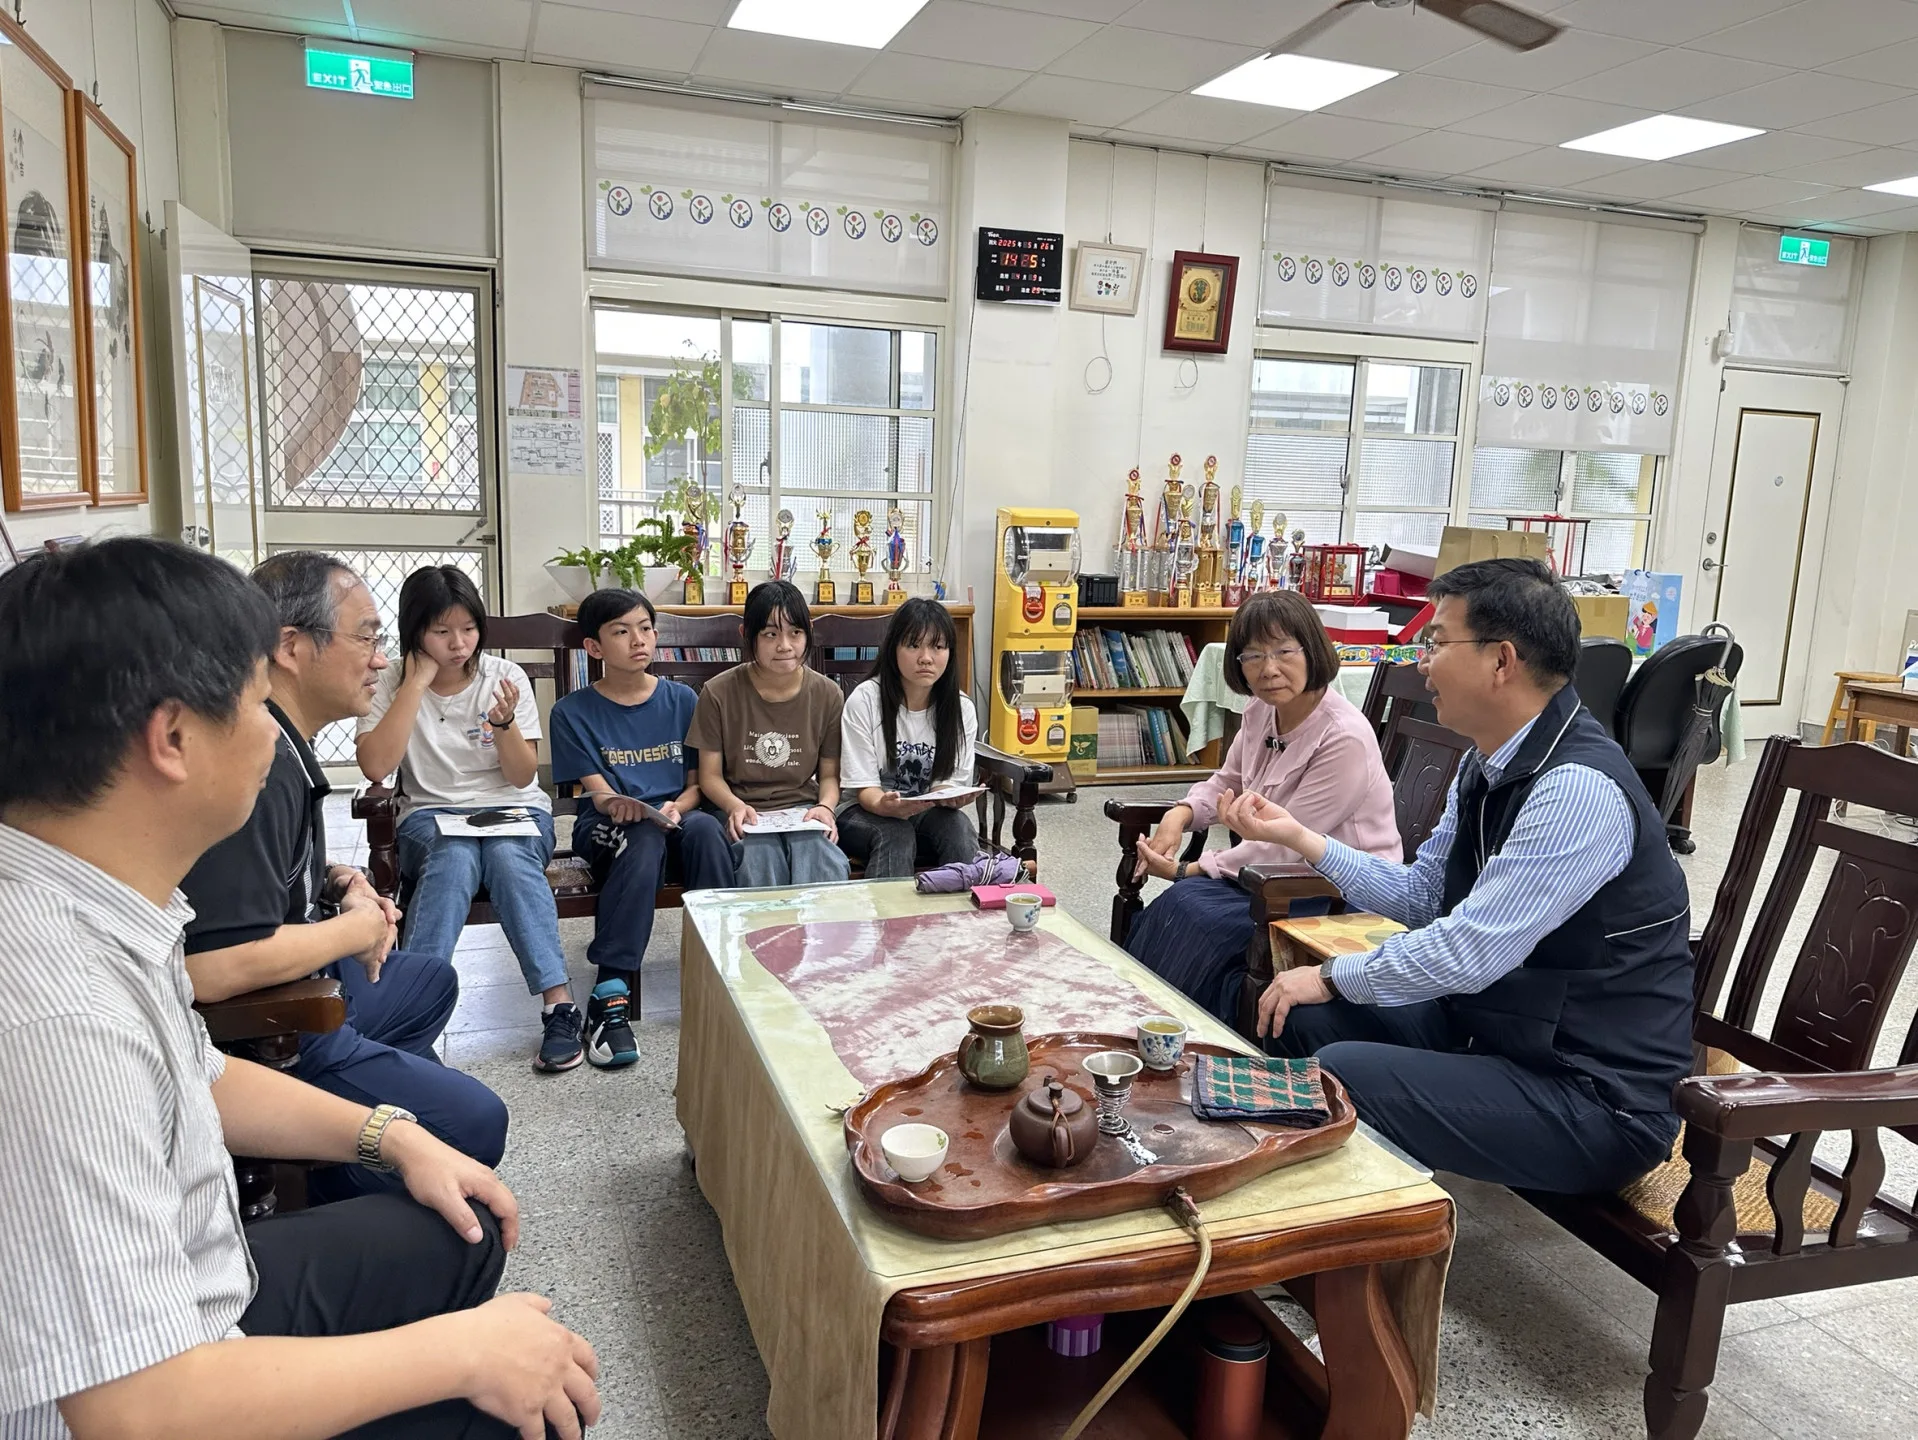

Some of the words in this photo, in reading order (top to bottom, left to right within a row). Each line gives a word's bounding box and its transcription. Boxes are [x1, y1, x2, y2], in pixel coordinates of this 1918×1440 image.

[312, 72, 347, 86] EXIT
[998, 239, 1016, 248] 2025
[1781, 251, 1798, 260] EXIT
